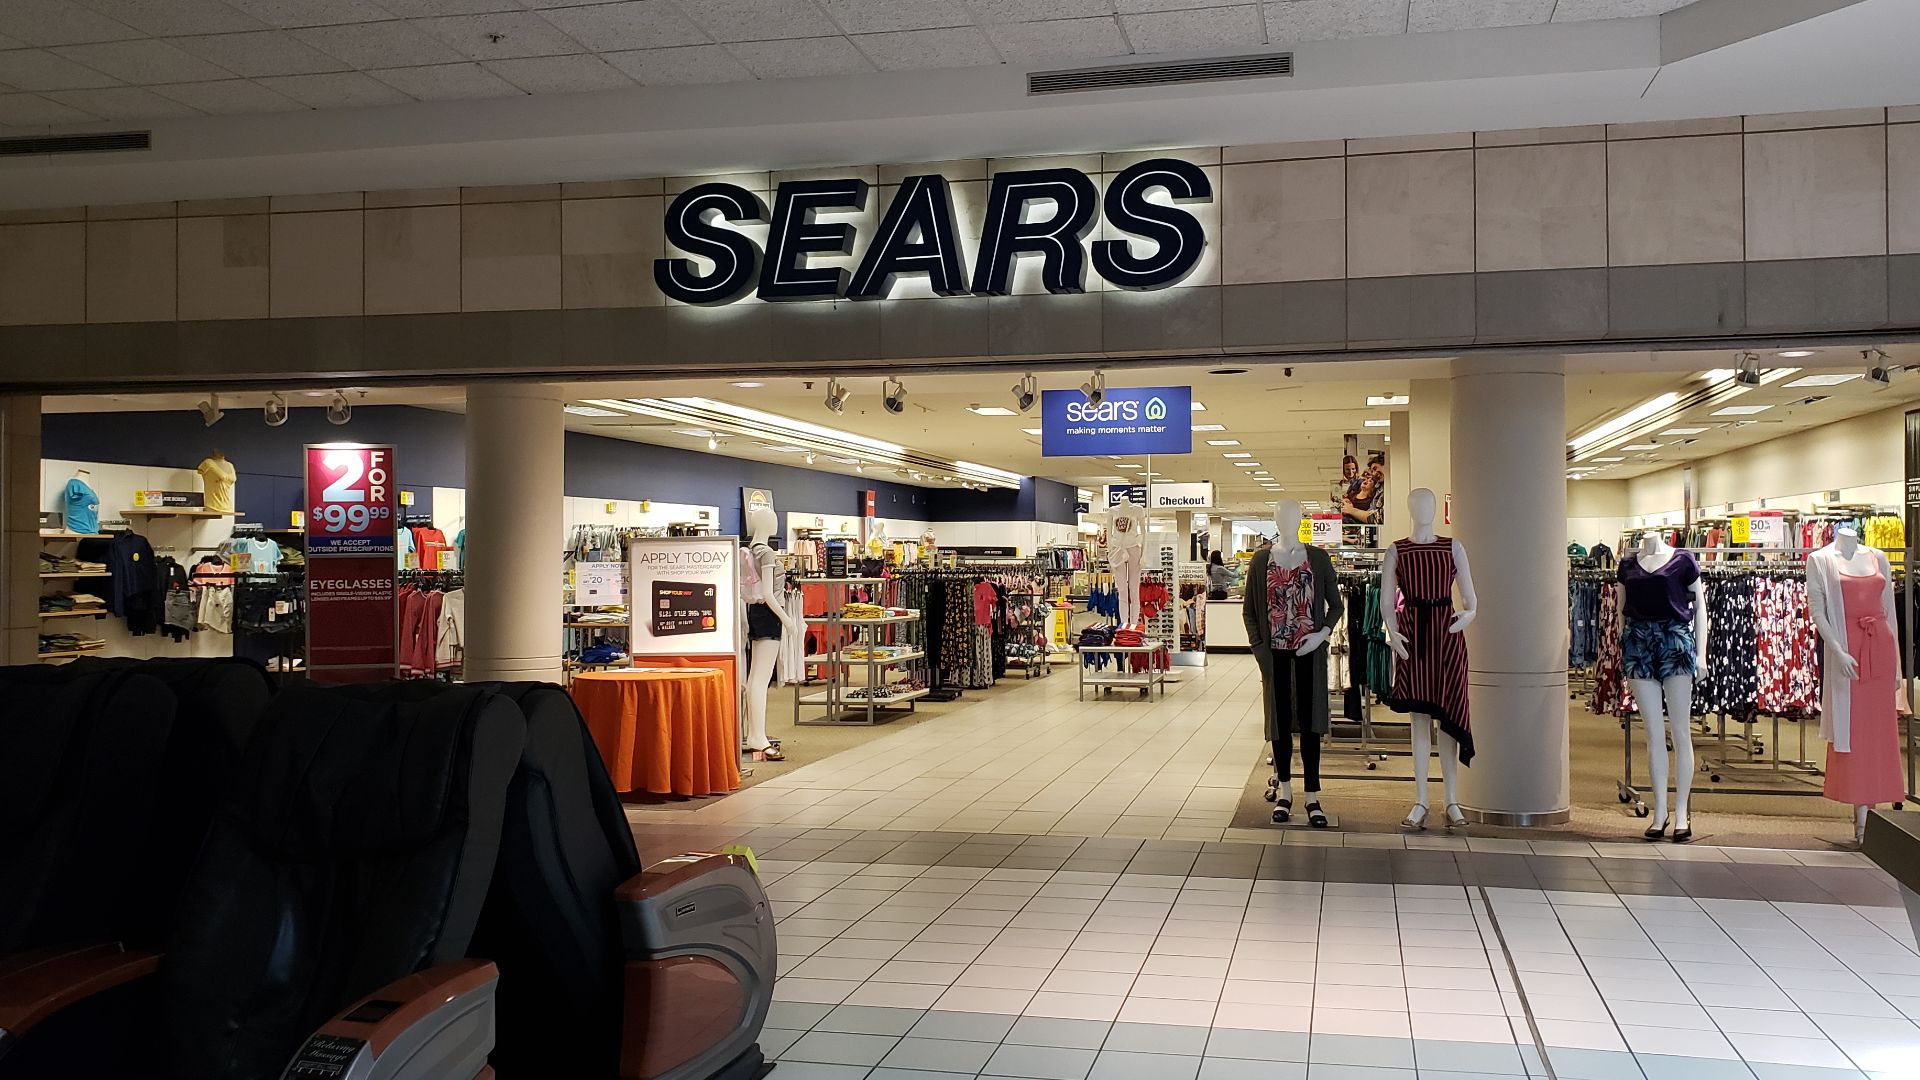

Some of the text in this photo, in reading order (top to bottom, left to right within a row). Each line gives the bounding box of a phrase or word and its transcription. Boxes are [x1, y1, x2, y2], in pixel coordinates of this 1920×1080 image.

[654, 158, 1213, 306] SEARS
[1066, 400, 1139, 422] sears
[1066, 425, 1166, 435] making moments matter
[322, 449, 365, 502] 2
[1159, 495, 1206, 506] Checkout
[640, 551, 730, 564] APPLY TODAY
[310, 579, 392, 590] EYEGLASSES
